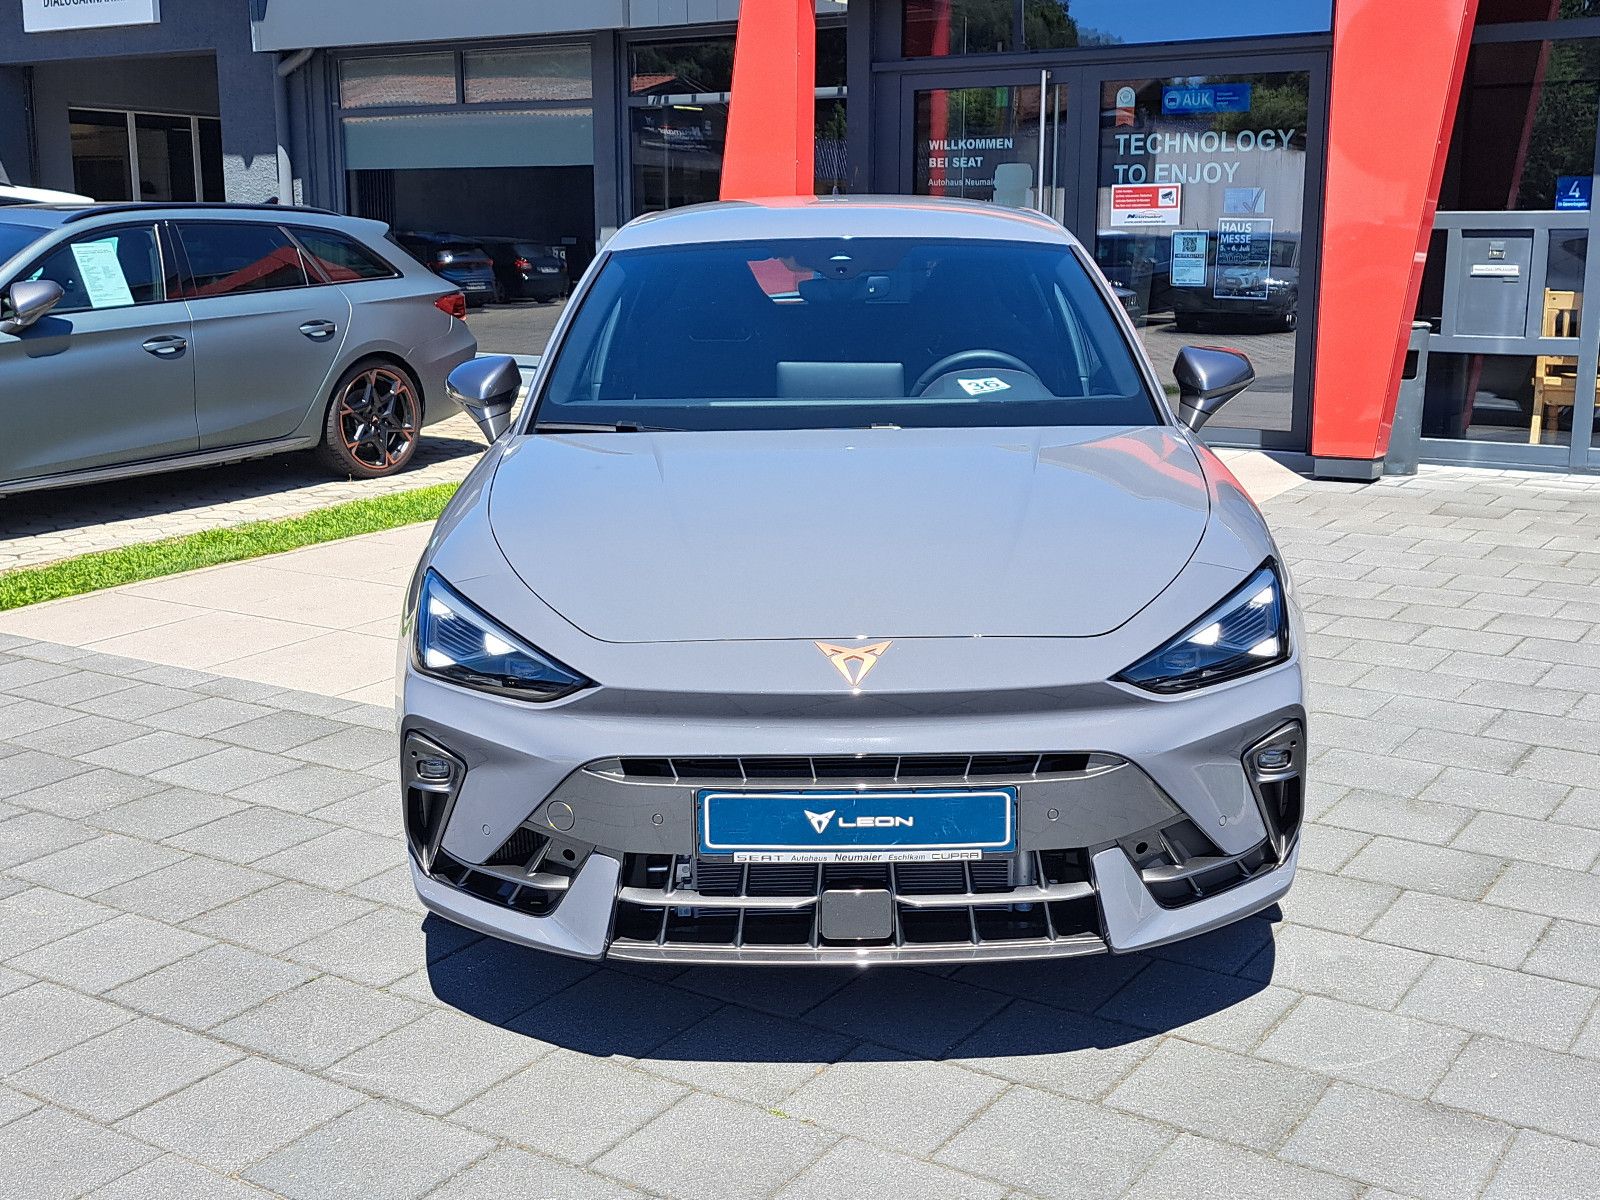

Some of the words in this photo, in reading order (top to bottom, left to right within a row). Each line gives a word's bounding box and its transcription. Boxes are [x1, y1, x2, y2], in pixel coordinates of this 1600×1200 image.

[928, 138, 1013, 150] WILLKOMMEN
[1114, 128, 1295, 155] TECHNOLOGY
[928, 157, 948, 168] BEI
[952, 156, 983, 167] SEAT
[1113, 163, 1148, 184] TO
[1154, 161, 1240, 184] ENJOY
[928, 178, 962, 187] Autohaus
[965, 177, 993, 186] Neumai
[1568, 180, 1581, 198] 4
[1221, 222, 1252, 233] HAUS
[1220, 234, 1252, 244] MESSE
[838, 816, 914, 827] LEON
[736, 854, 785, 862] SEAT
[790, 854, 828, 862] Autohaus
[834, 853, 883, 862] Neumaier
[931, 852, 979, 860] CUPRA
